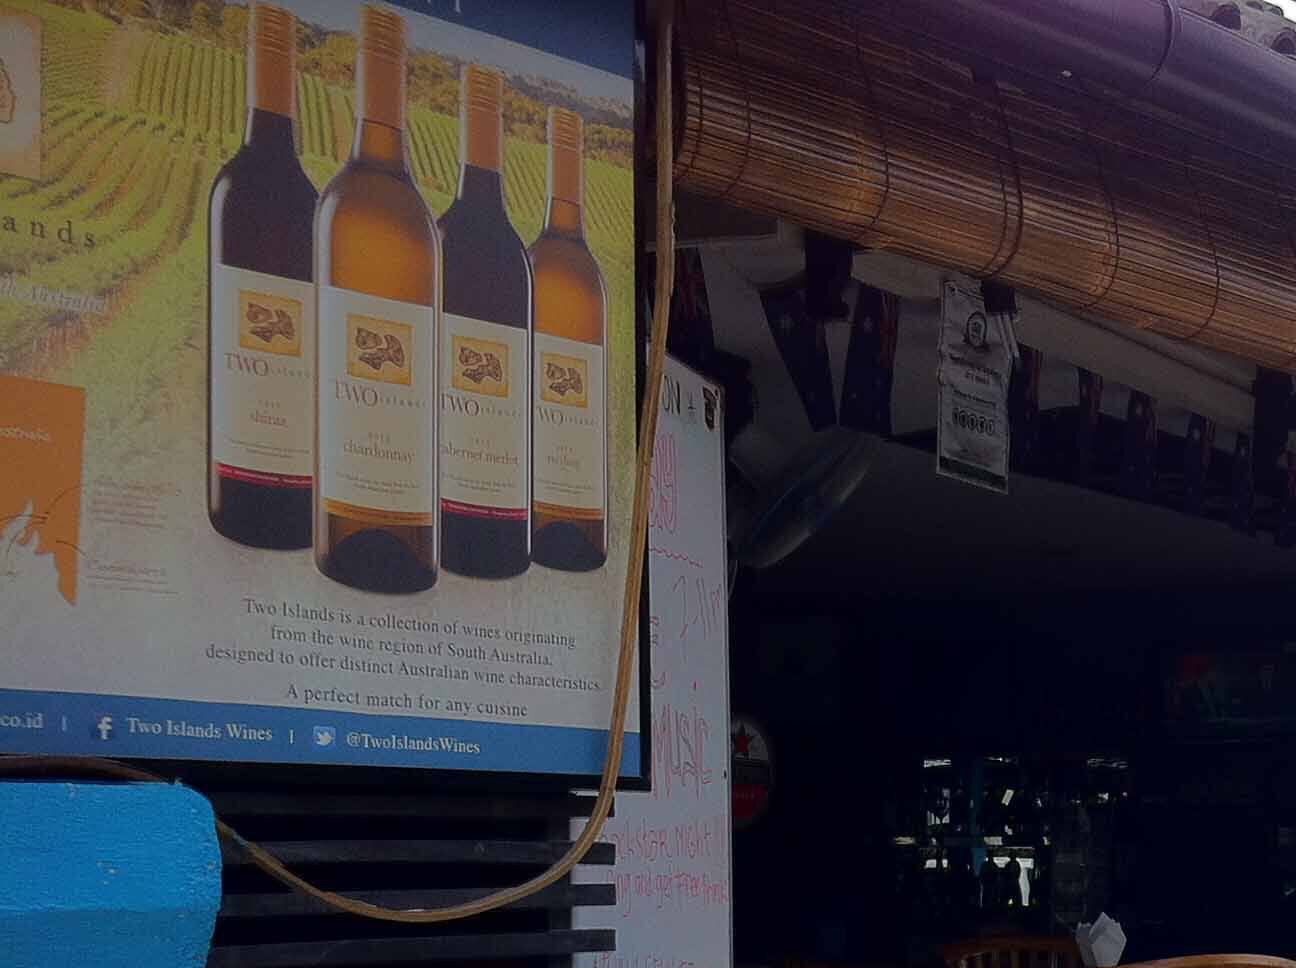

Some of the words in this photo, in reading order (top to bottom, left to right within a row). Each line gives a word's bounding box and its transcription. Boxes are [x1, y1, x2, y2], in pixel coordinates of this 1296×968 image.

[2, 215, 96, 248] ands
[225, 353, 268, 377] TWO
[335, 379, 378, 407] TWO
[441, 393, 480, 417] TWO
[536, 407, 564, 425] WO
[344, 440, 415, 463] chardonnay
[441, 440, 481, 464] abernet
[241, 598, 277, 615] Two
[283, 602, 335, 622] Islands
[340, 609, 352, 624] is
[357, 616, 365, 625] a
[370, 613, 439, 633] collection
[444, 620, 458, 635] of
[462, 625, 500, 640] wines
[505, 630, 576, 649] originating
[271, 625, 306, 642] from
[312, 628, 334, 646] the
[340, 635, 373, 651] wine
[379, 640, 424, 656] region
[429, 641, 443, 657] of
[447, 643, 486, 661] South
[206, 644, 274, 664] designed
[280, 648, 294, 665] to
[299, 652, 336, 669] offer
[340, 656, 393, 675] distinct
[400, 662, 469, 681] Australian
[474, 670, 505, 684] wine
[510, 671, 601, 691] characteristics
[287, 684, 298, 699] A
[304, 686, 360, 704] perfect
[367, 692, 412, 709] match
[419, 694, 440, 710] for
[446, 700, 470, 716] any
[477, 701, 528, 717] cuisine
[127, 717, 162, 734] Two
[167, 719, 222, 740] Islands
[225, 723, 273, 741] Wines
[346, 731, 481, 754] @TwoIslandsWines
